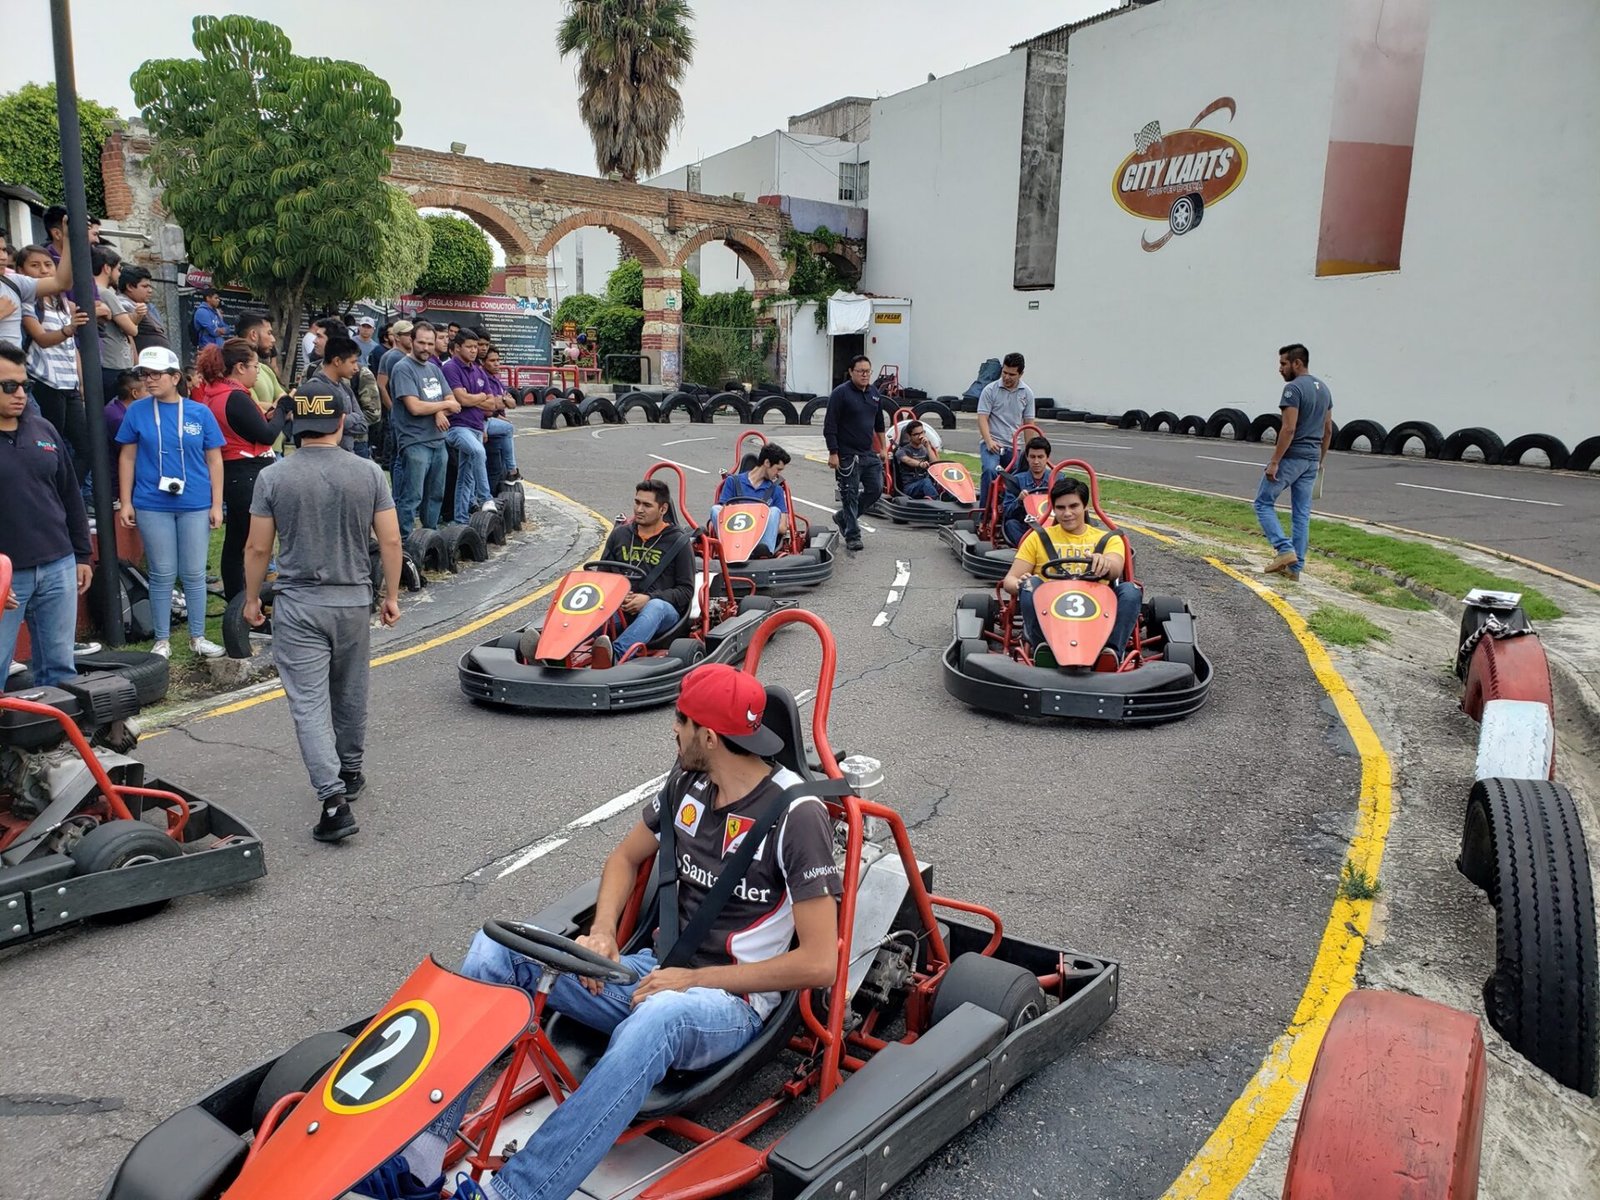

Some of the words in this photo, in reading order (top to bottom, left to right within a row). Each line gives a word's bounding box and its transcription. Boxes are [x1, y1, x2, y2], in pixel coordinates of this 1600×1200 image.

[1121, 157, 1167, 193] CITY
[1163, 147, 1235, 187] KARTS
[187, 274, 201, 282] CITY
[427, 299, 454, 308] REGLAS
[454, 300, 471, 308] PARA
[471, 301, 480, 309] EL
[480, 302, 516, 311] CONDUCTOR
[947, 469, 958, 480] 7
[733, 514, 747, 530] 5
[621, 545, 663, 566] VANS
[569, 584, 590, 609] 6
[1065, 594, 1086, 617] 3
[335, 1015, 418, 1100] 2
